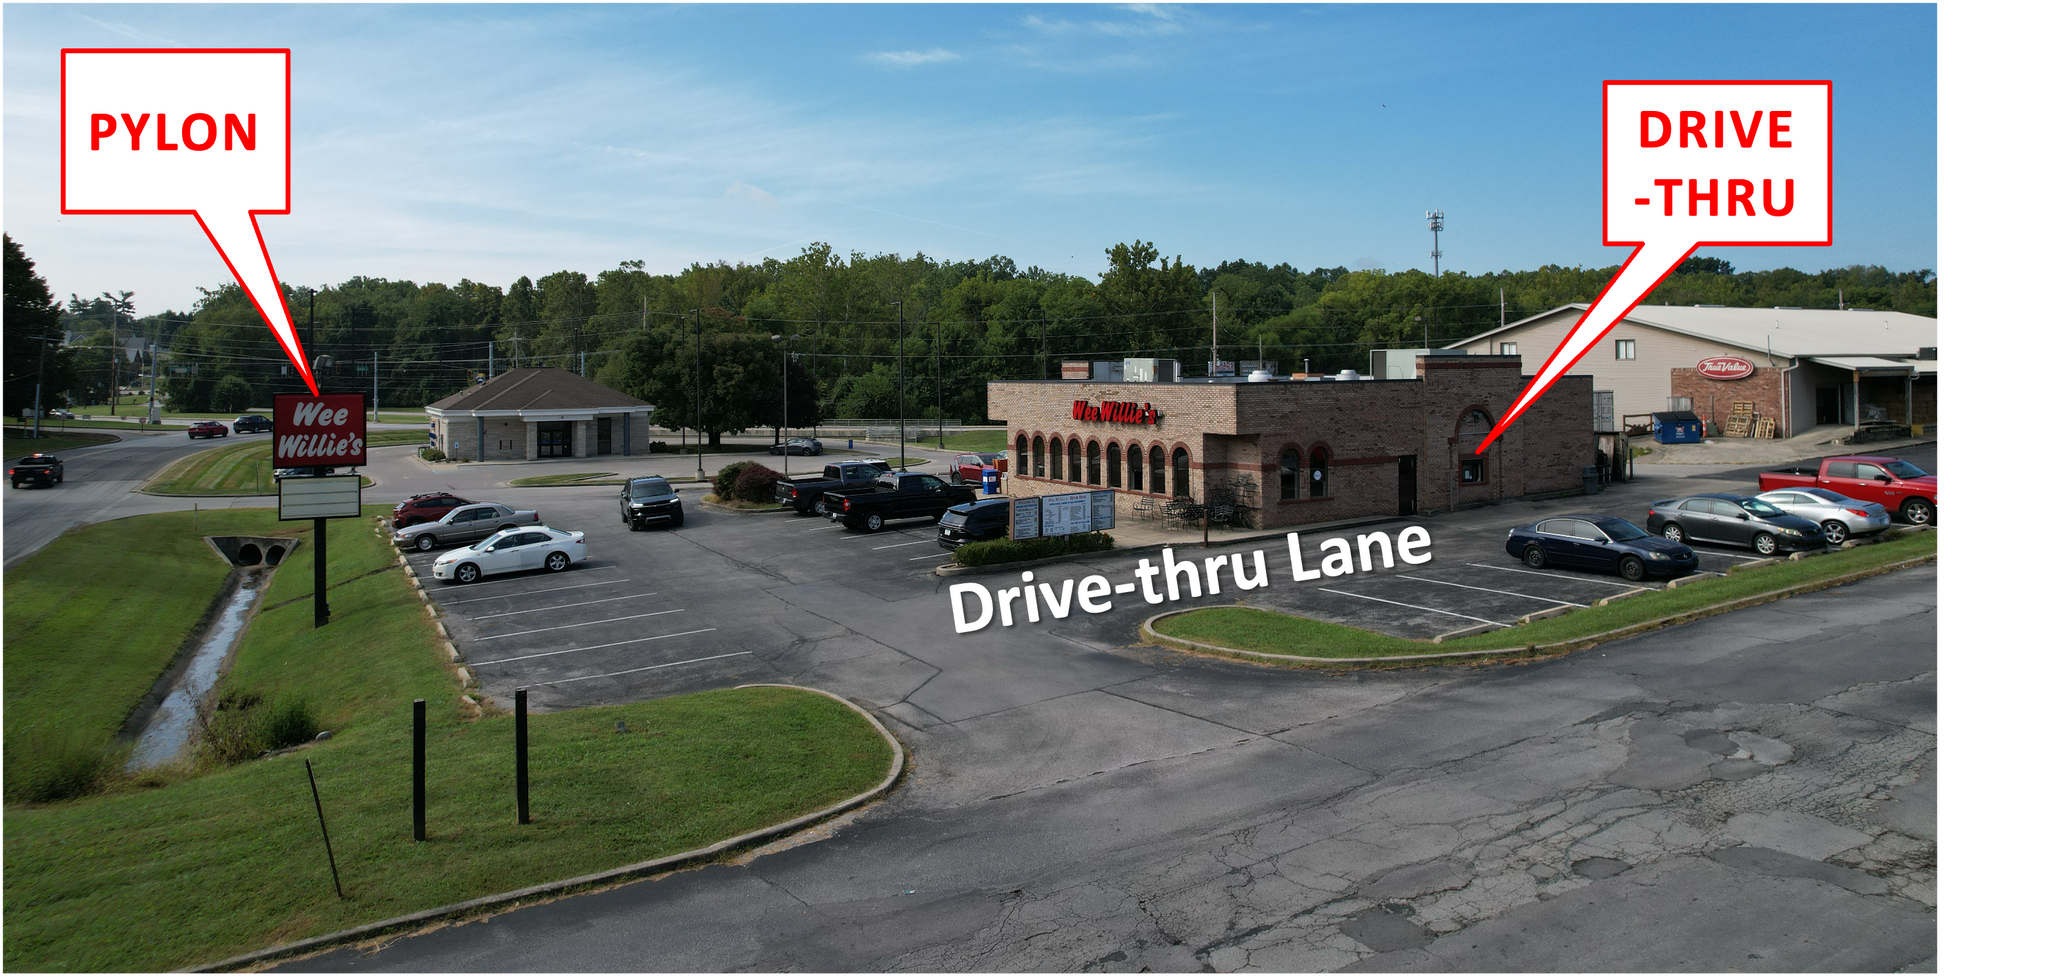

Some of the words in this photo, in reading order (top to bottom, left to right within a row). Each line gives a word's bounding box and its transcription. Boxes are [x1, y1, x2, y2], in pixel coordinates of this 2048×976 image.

[1702, 362, 1721, 372] True
[1717, 361, 1747, 372] Value
[293, 402, 348, 426] Wee
[1072, 400, 1100, 421] Wee
[1101, 401, 1158, 425] Willie's
[278, 432, 363, 459] Willie's
